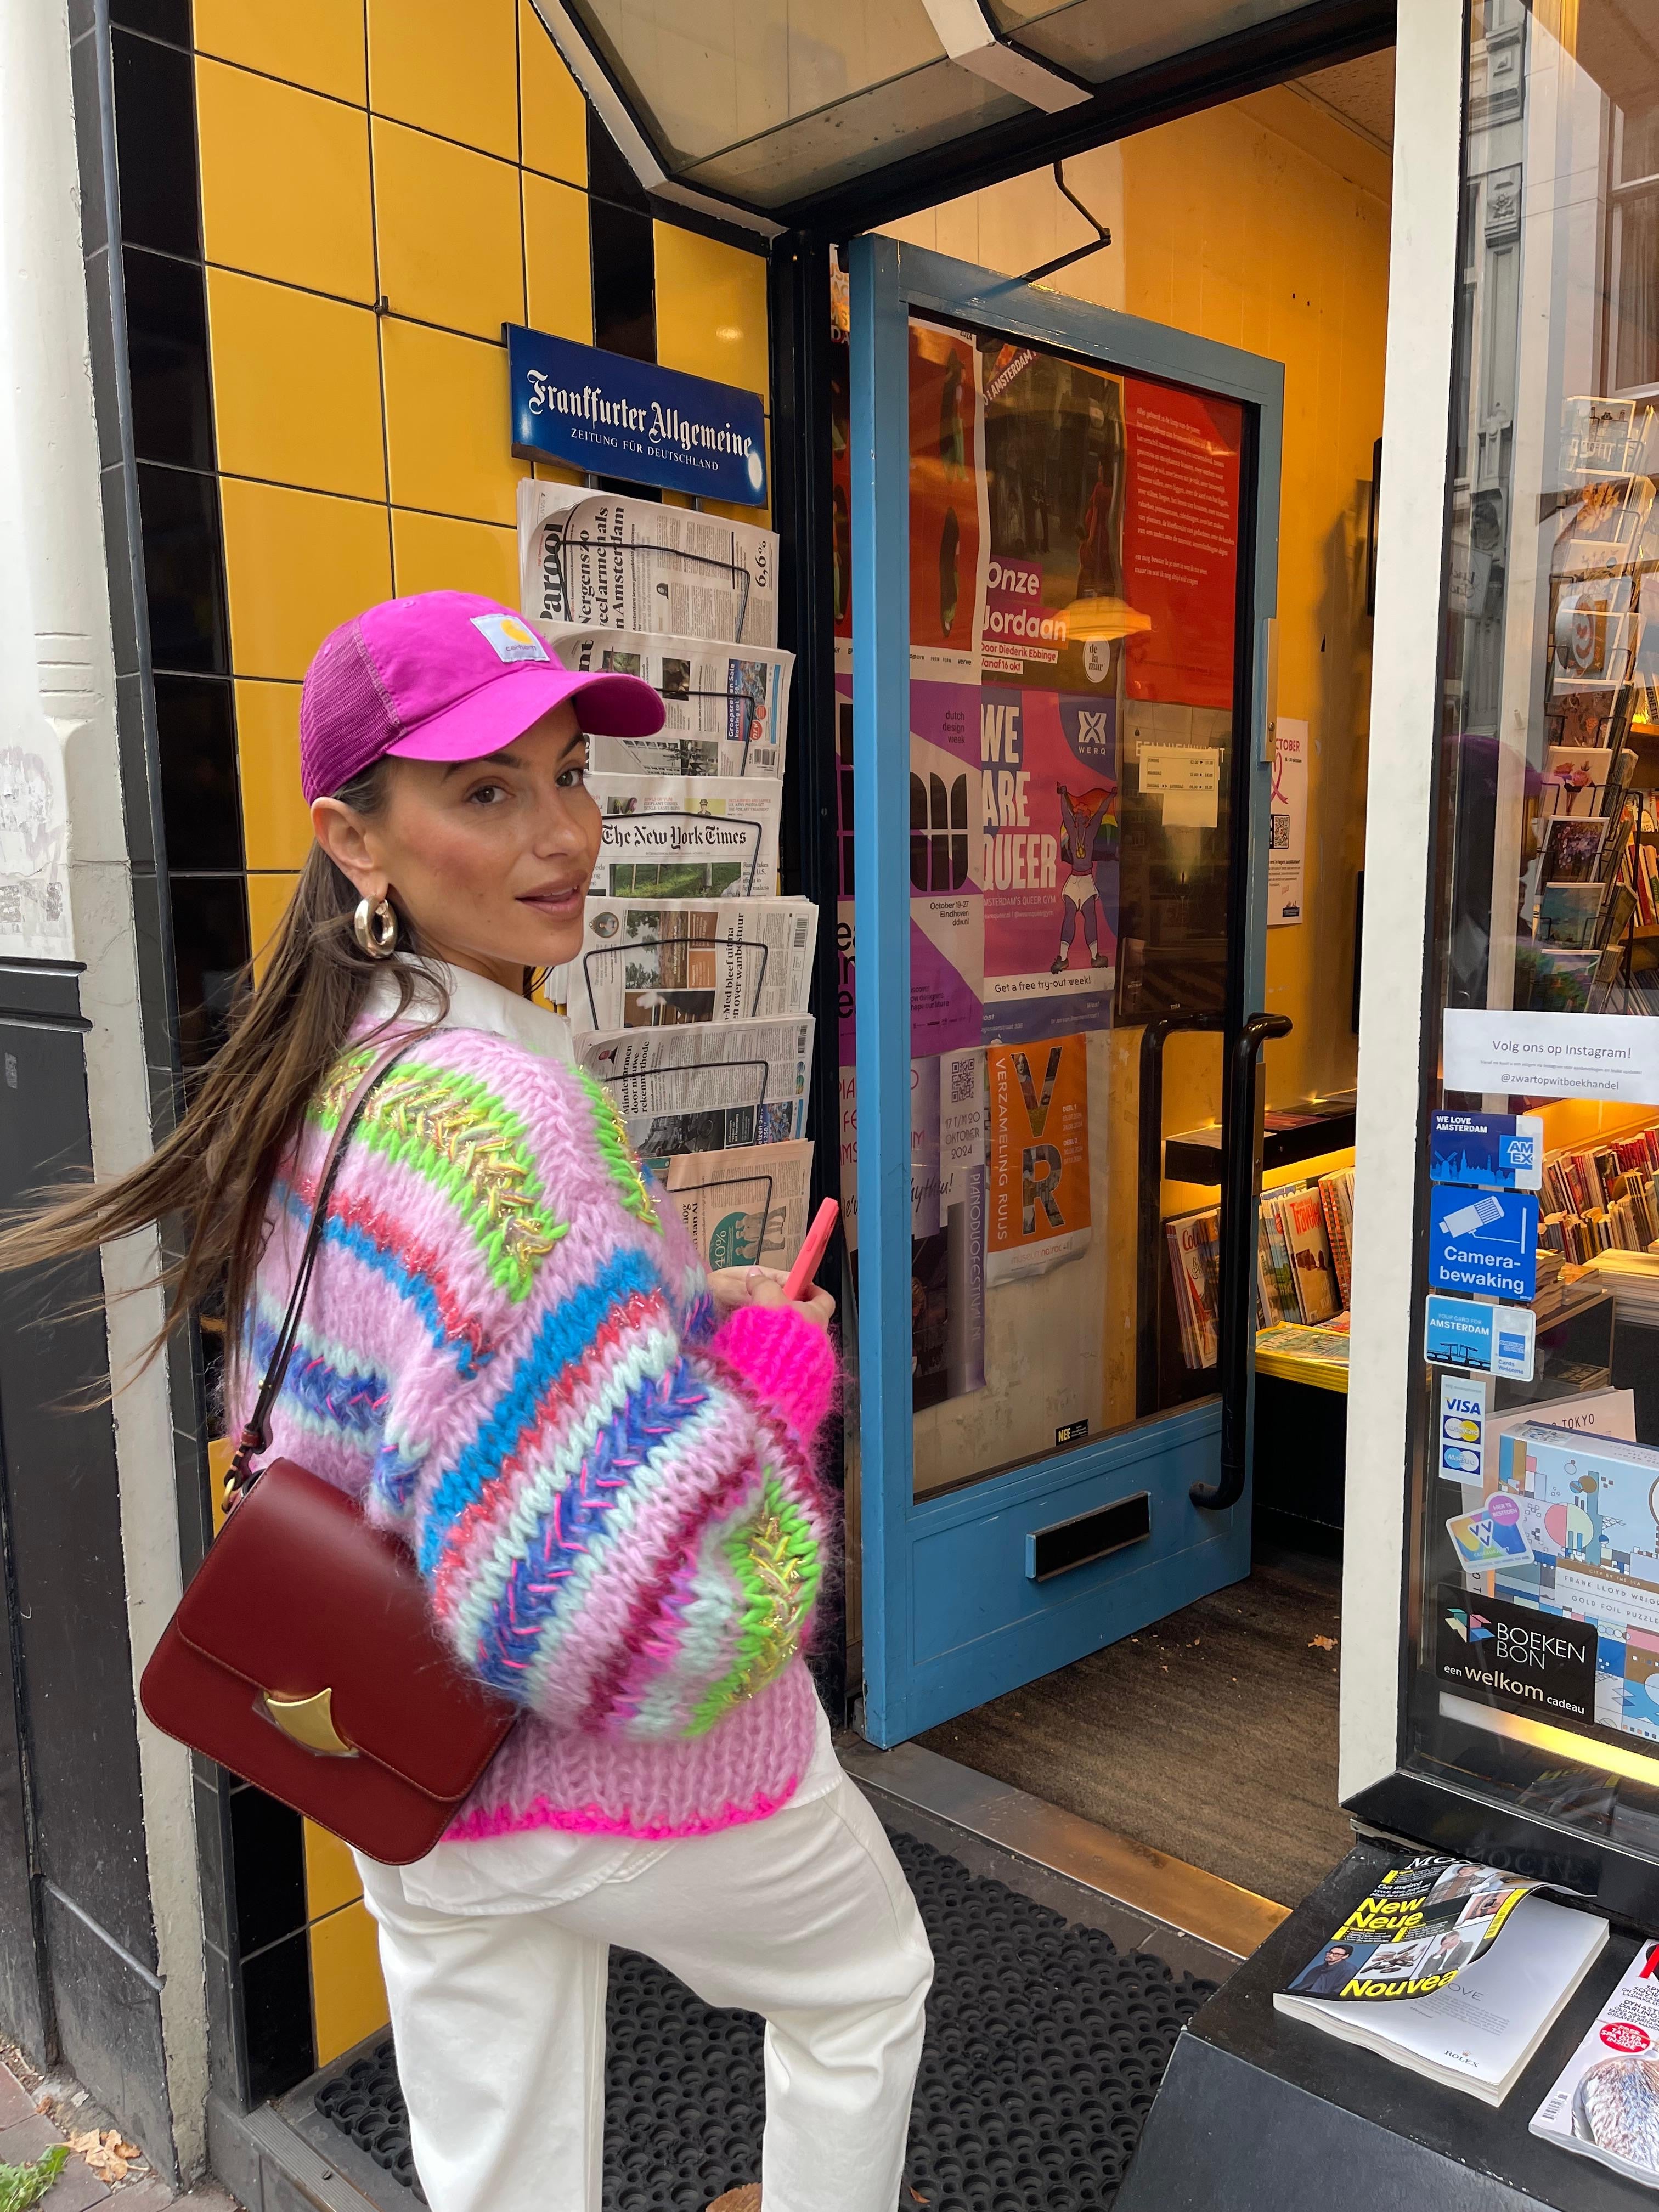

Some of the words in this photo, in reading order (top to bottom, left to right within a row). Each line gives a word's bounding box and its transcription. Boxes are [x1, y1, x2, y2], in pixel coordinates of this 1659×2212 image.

[991, 349, 1032, 398] AMSTERDAM
[527, 369, 647, 433] Frankfurter
[649, 401, 753, 459] Allgemeine
[571, 428, 618, 448] ZEITUNG
[623, 439, 643, 454] FÜR
[647, 445, 719, 471] DEUTSCHLAND
[595, 507, 608, 533] als
[597, 535, 608, 596] armen
[610, 507, 624, 617] Amsterdam
[754, 540, 768, 588] 6,6%
[987, 562, 1039, 595] Onze
[982, 605, 1066, 641] Jordaan
[999, 645, 1028, 657] Diederik
[1029, 649, 1056, 662] Ebbinge
[1090, 644, 1098, 653] de
[1002, 660, 1008, 670] 16
[1009, 661, 1021, 672] okt
[1089, 663, 1103, 672] mar
[1646, 686, 1659, 721] VENETIE
[945, 710, 965, 721] dutch
[942, 722, 965, 734] design
[980, 704, 1020, 763] WE
[947, 735, 965, 744] week
[1078, 746, 1106, 755] WERQ
[982, 770, 1030, 827] ARE
[602, 824, 631, 848] The
[634, 826, 667, 847] New
[670, 826, 703, 850] York
[705, 825, 746, 845] Times
[983, 834, 1057, 891] QUEER
[1023, 896, 1041, 905] QUEER
[1042, 895, 1056, 904] GYM
[733, 913, 744, 979] wanbestuur
[724, 959, 734, 989] bleef
[995, 984, 1009, 993] Get
[1019, 981, 1036, 991] free
[1038, 979, 1066, 991] try-out
[1068, 975, 1091, 986] week!
[733, 982, 742, 1007] over
[1492, 1041, 1520, 1053] Volg
[1523, 1043, 1543, 1053] ons
[1548, 1046, 1562, 1055] op
[1566, 1044, 1632, 1059] Instagram!
[623, 1045, 633, 1076] armen
[640, 1041, 650, 1113] rekenmethode
[1501, 1073, 1619, 1090] @zwartopwitboekhandel
[622, 1077, 630, 1114] Minder
[1010, 1047, 1063, 1138] V
[968, 1111, 980, 1124] 20
[996, 1058, 1008, 1186] VERZAMELING
[1451, 1116, 1471, 1125] LOVE
[946, 1128, 979, 1145] OKTOBER
[1436, 1124, 1487, 1133] AMSTERDAM
[951, 1144, 972, 1159] 2024
[1509, 1141, 1533, 1152] AM
[1512, 1153, 1533, 1164] EX
[1022, 1143, 1065, 1235] R
[691, 1203, 698, 1214] AI
[998, 1193, 1008, 1240] RUIJS
[715, 1230, 726, 1269] 40%
[1444, 1246, 1521, 1269] Camera-
[1440, 1266, 1524, 1294] bewaking
[1430, 1318, 1489, 1335] AMSTERDAM
[1498, 1365, 1523, 1374] Welcome
[1447, 1398, 1481, 1415] VISA
[1562, 1413, 1595, 1429] TOKYO
[1058, 1427, 1071, 1442] NEE
[1492, 1509, 1518, 1517] BESTEDEN
[1565, 1575, 1592, 1587] FRANK
[1597, 1584, 1627, 1596] LLOYD
[1572, 1595, 1595, 1606] GOLD
[1601, 1604, 1621, 1613] FOIL
[1497, 1622, 1585, 1663] BOEKEN
[1497, 1640, 1545, 1670] BON
[1444, 1664, 1463, 1677] een
[1465, 1666, 1544, 1702] welkom
[1547, 1695, 1585, 1714] cadeau
[1393, 1880, 1423, 1891] inspired
[1356, 1896, 1426, 1914] New
[1344, 1911, 1424, 1928] Neue
[1339, 1969, 1459, 1999] Nouvea
[1622, 1992, 1651, 2004] LASHANA
[1607, 2012, 1637, 2023] GREATEST
[1608, 2008, 1627, 2017] FACES
[1601, 2029, 1617, 2039] SPA
[1619, 2035, 1648, 2049] GUIDE
[1606, 2036, 1635, 2050] INSIDE
[1612, 2027, 1642, 2041] TATLER
[1444, 2050, 1479, 2067] ROLEX
